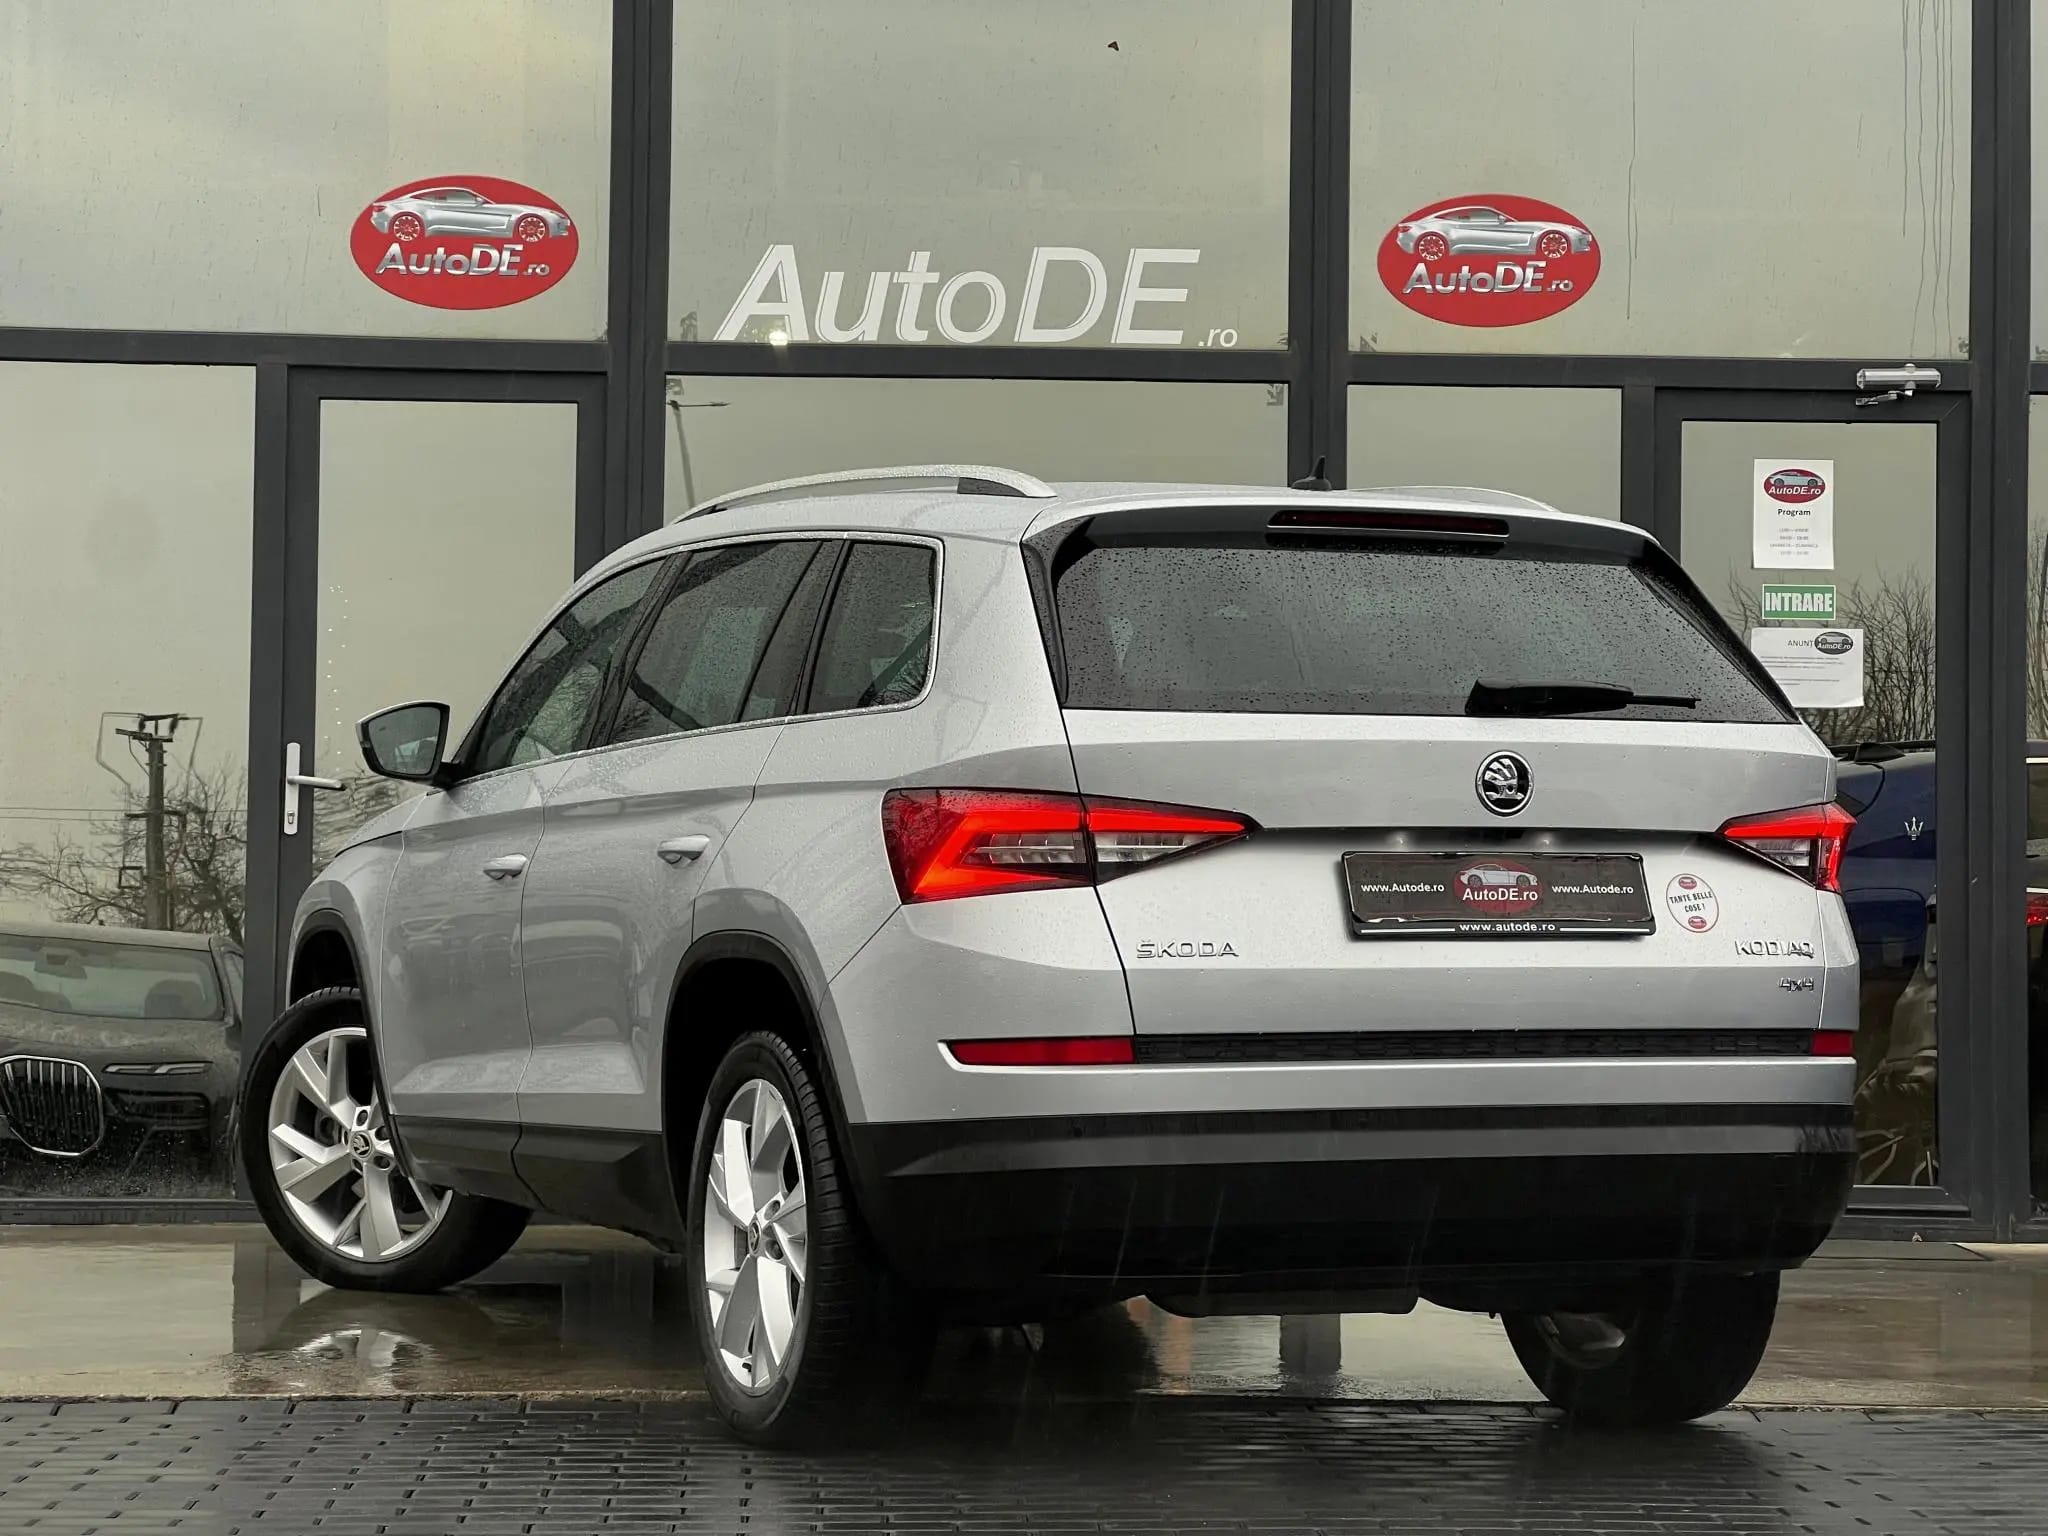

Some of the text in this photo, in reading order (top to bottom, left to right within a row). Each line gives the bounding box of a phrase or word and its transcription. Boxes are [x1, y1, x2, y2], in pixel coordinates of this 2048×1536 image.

[1768, 486, 1822, 495] AutoDE.ro
[1777, 508, 1811, 517] Program
[1765, 592, 1833, 612] INTRARE
[1361, 882, 1445, 893] www.Autode.ro
[1551, 884, 1634, 895] www.Autode.ro
[1462, 887, 1539, 902] AutoDE.ro
[1669, 891, 1713, 904] TANTE BELLE
[1459, 922, 1556, 932] www.autode.ro
[1734, 940, 1815, 959] KODIAQ
